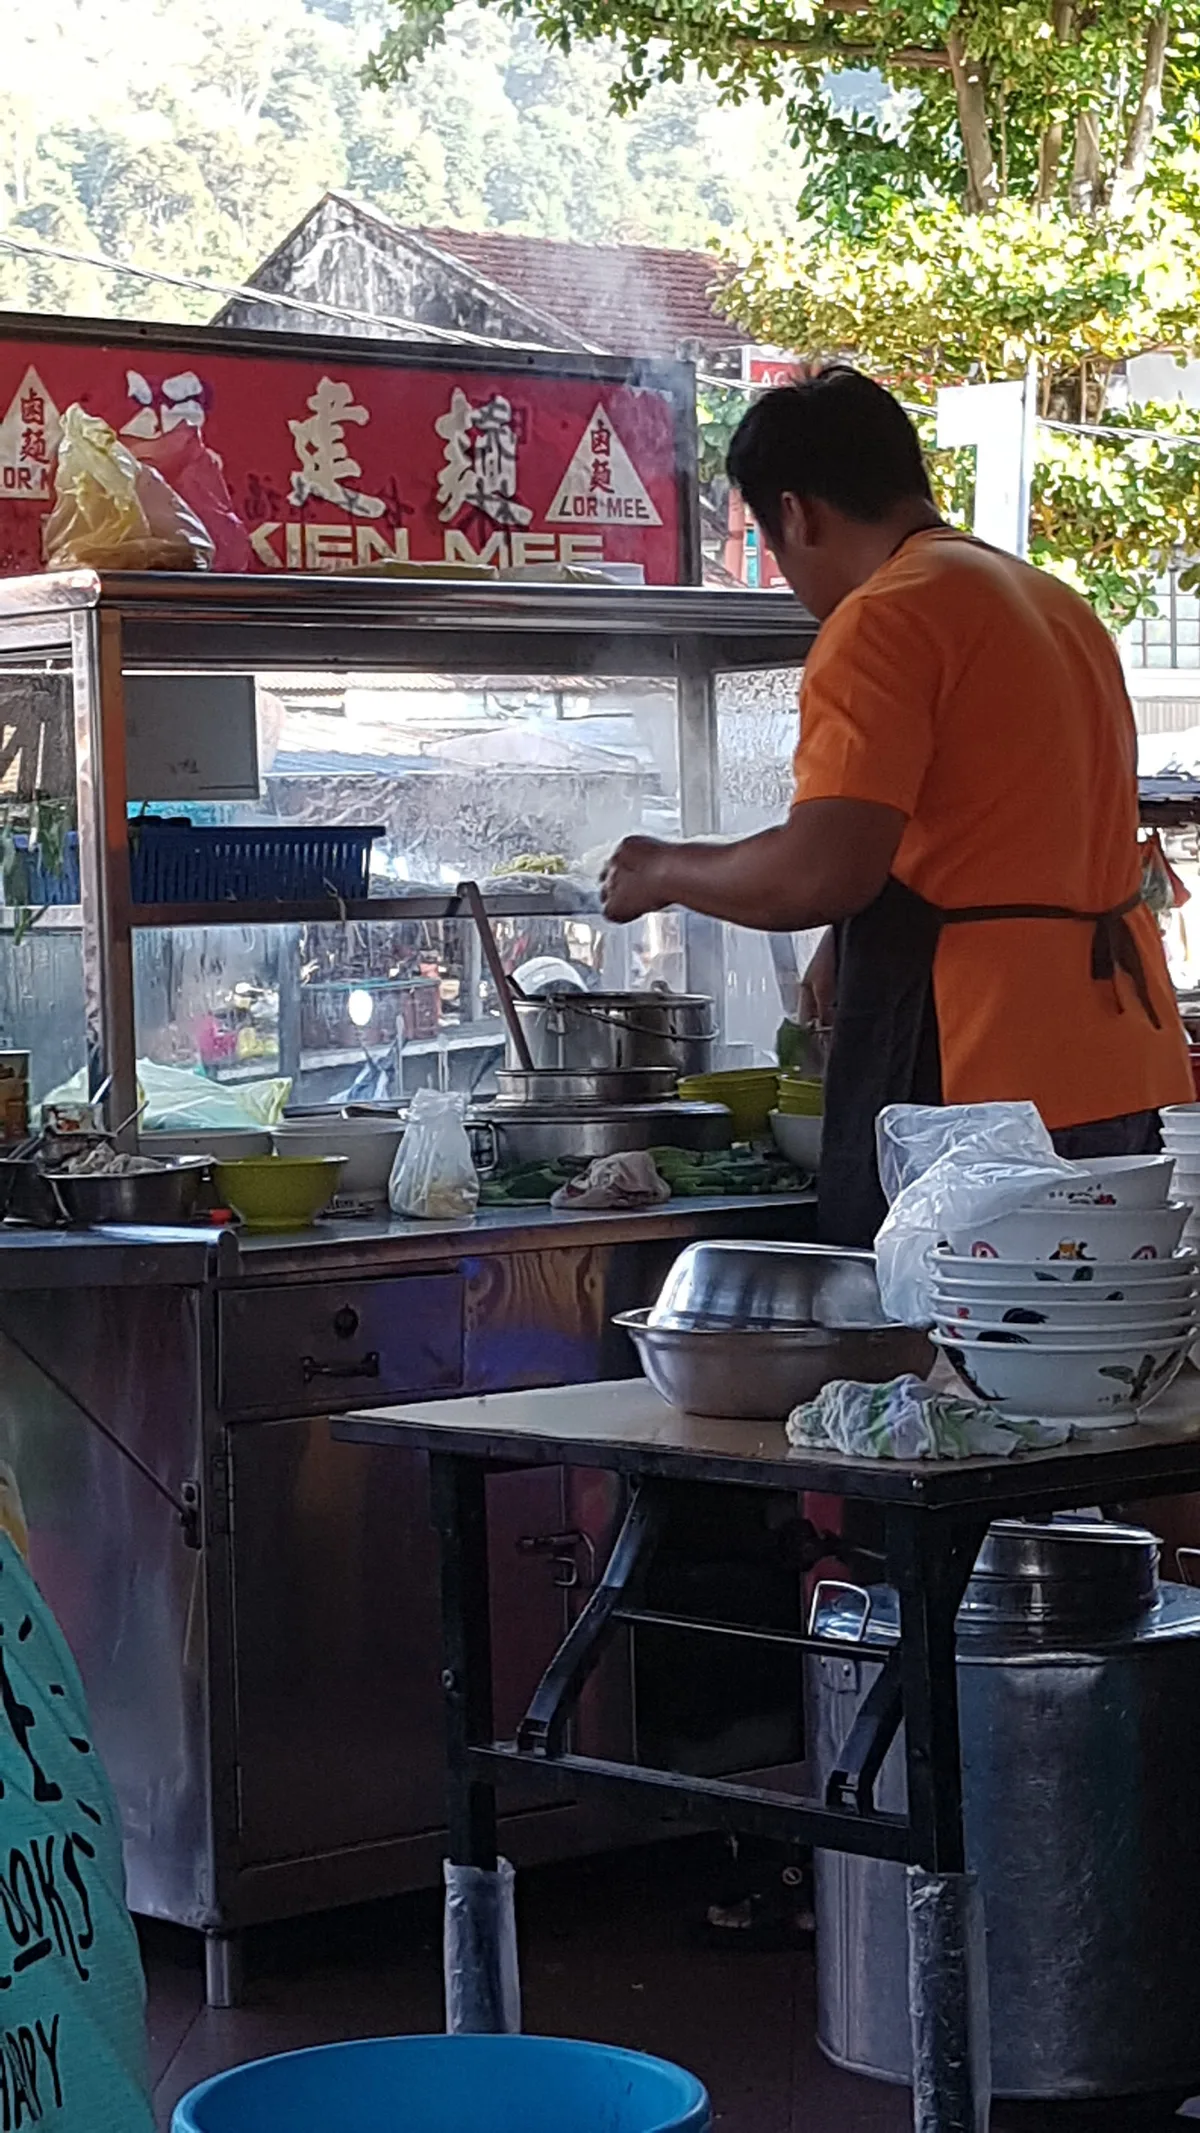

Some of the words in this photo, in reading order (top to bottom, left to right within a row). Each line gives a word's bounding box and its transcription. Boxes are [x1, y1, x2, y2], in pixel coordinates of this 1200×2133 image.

[0, 465, 33, 491] OR
[558, 495, 598, 517] LOR
[606, 498, 650, 519] MEE
[444, 529, 603, 568] MEE
